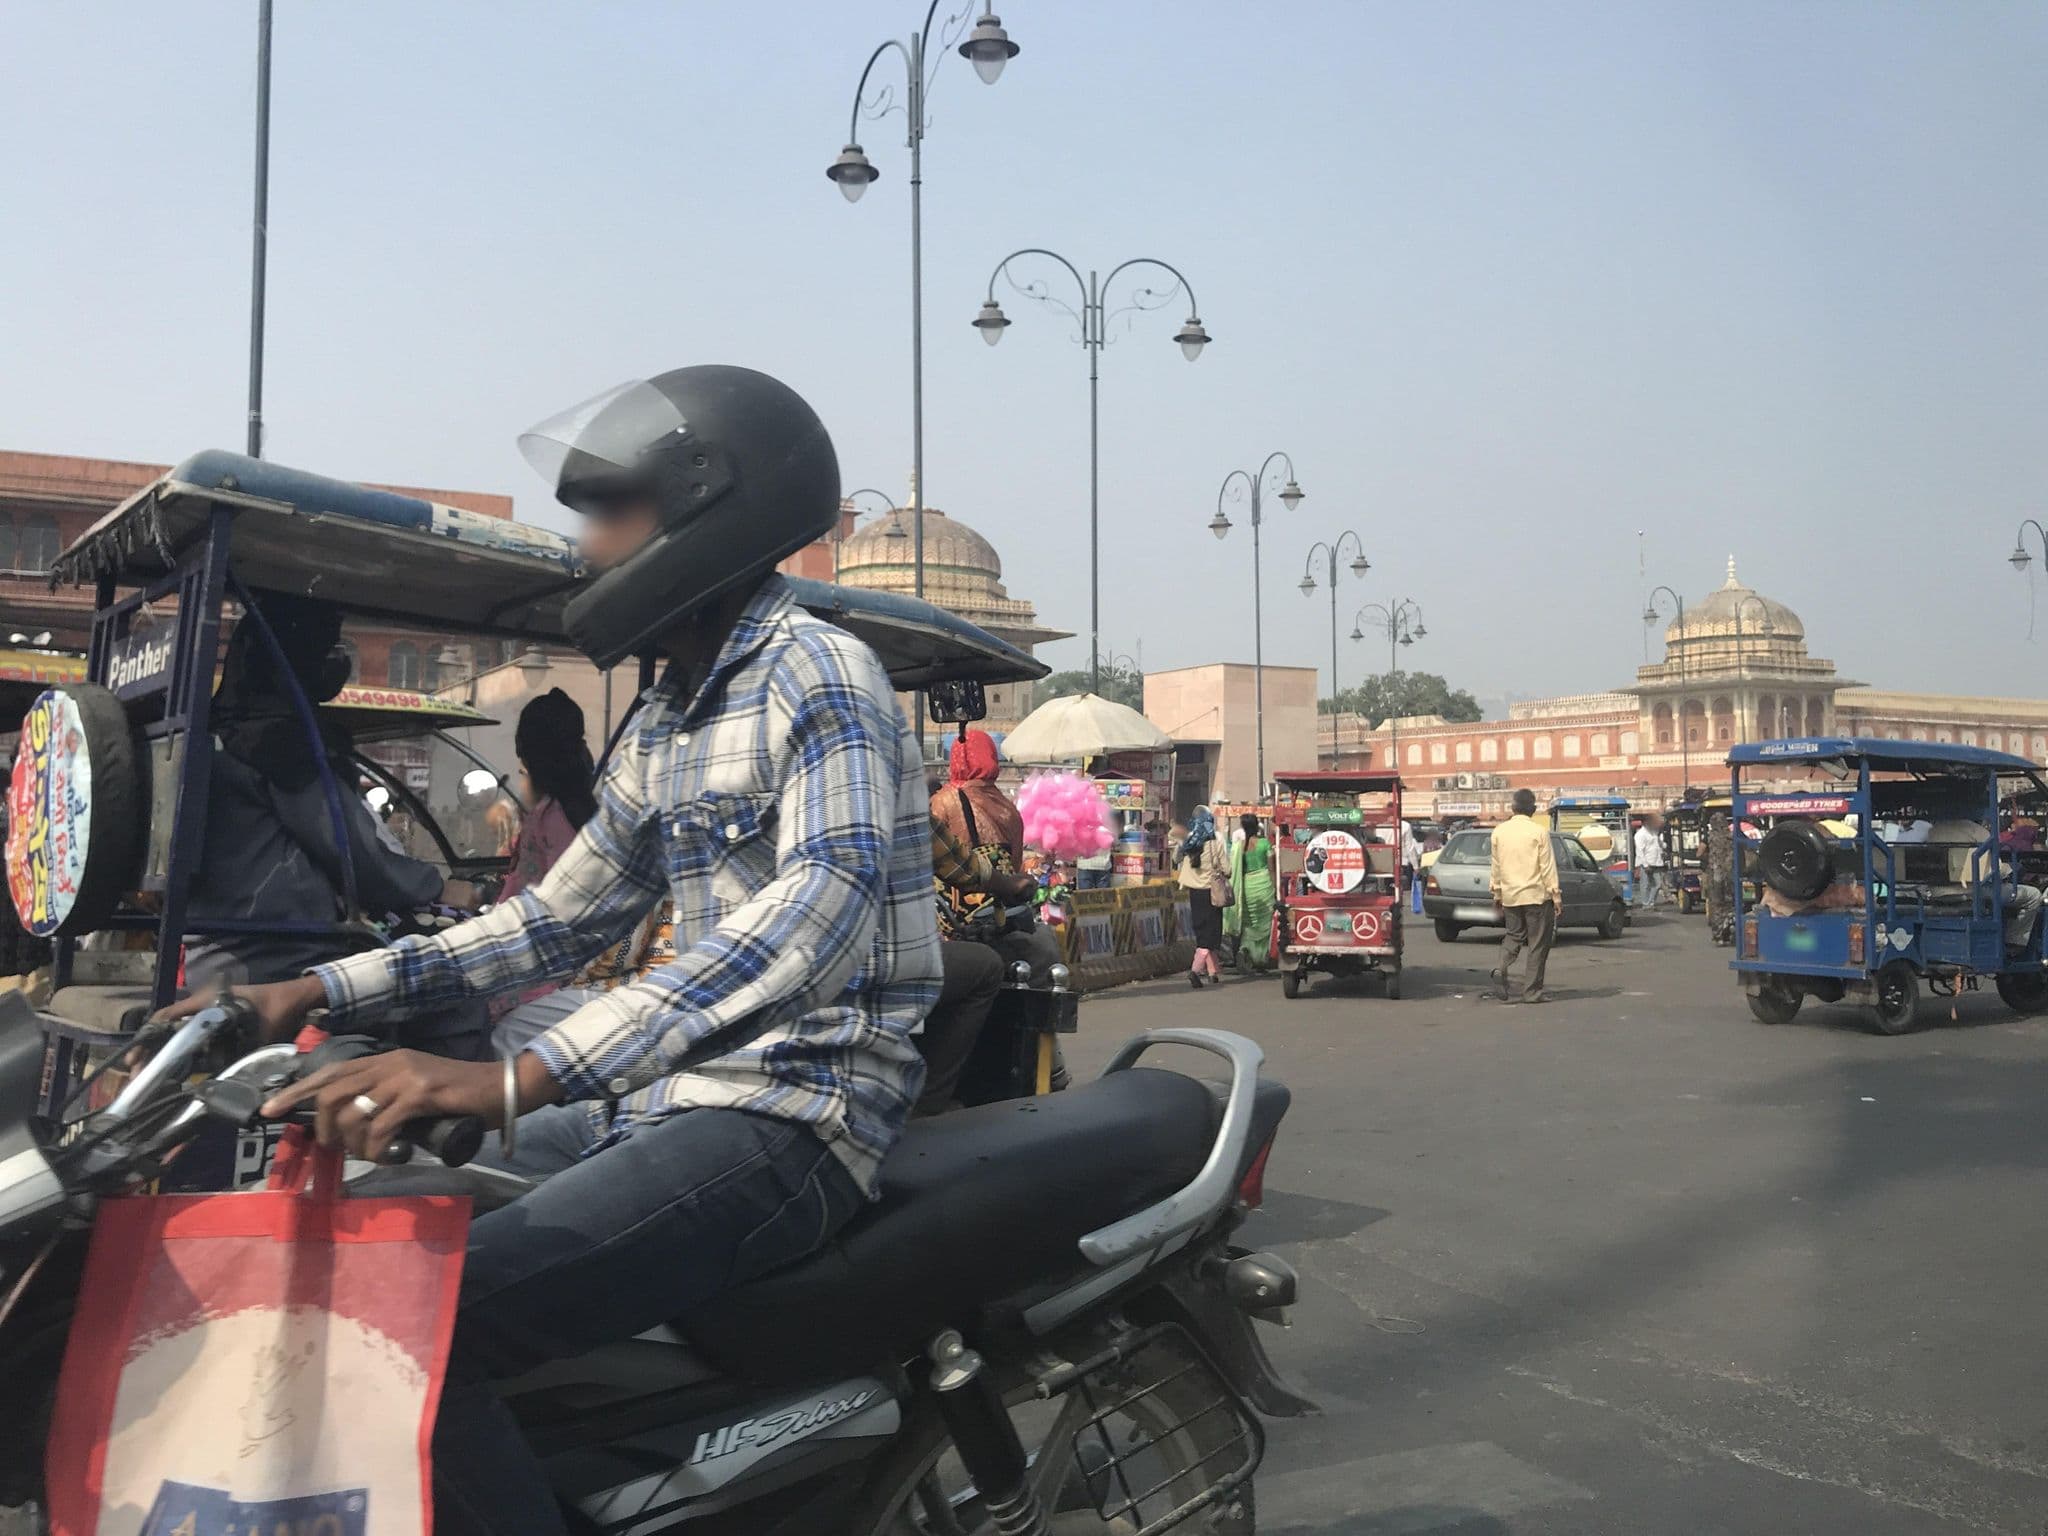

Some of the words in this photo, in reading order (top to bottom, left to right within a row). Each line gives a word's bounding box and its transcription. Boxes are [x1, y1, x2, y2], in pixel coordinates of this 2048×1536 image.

[108, 641, 171, 690] Panther
[689, 1418, 756, 1465] HF
[756, 1388, 879, 1448] Deluxe
